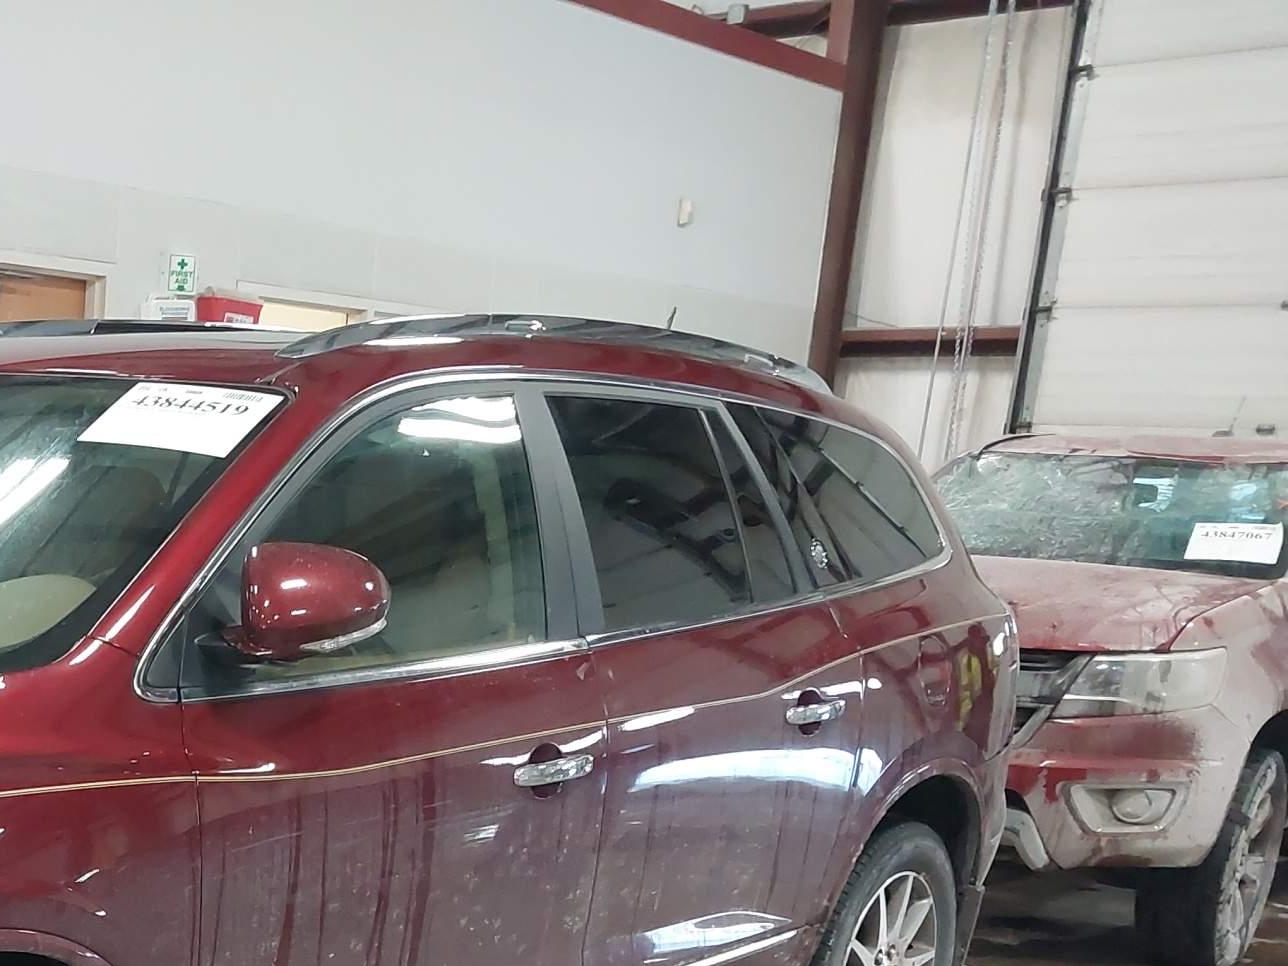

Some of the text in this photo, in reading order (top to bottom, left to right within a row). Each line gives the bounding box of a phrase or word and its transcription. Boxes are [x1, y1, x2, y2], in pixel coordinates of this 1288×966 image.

[170, 270, 194, 278] FIRST
[131, 394, 249, 416] 43844519
[1201, 531, 1273, 540] 43847067
